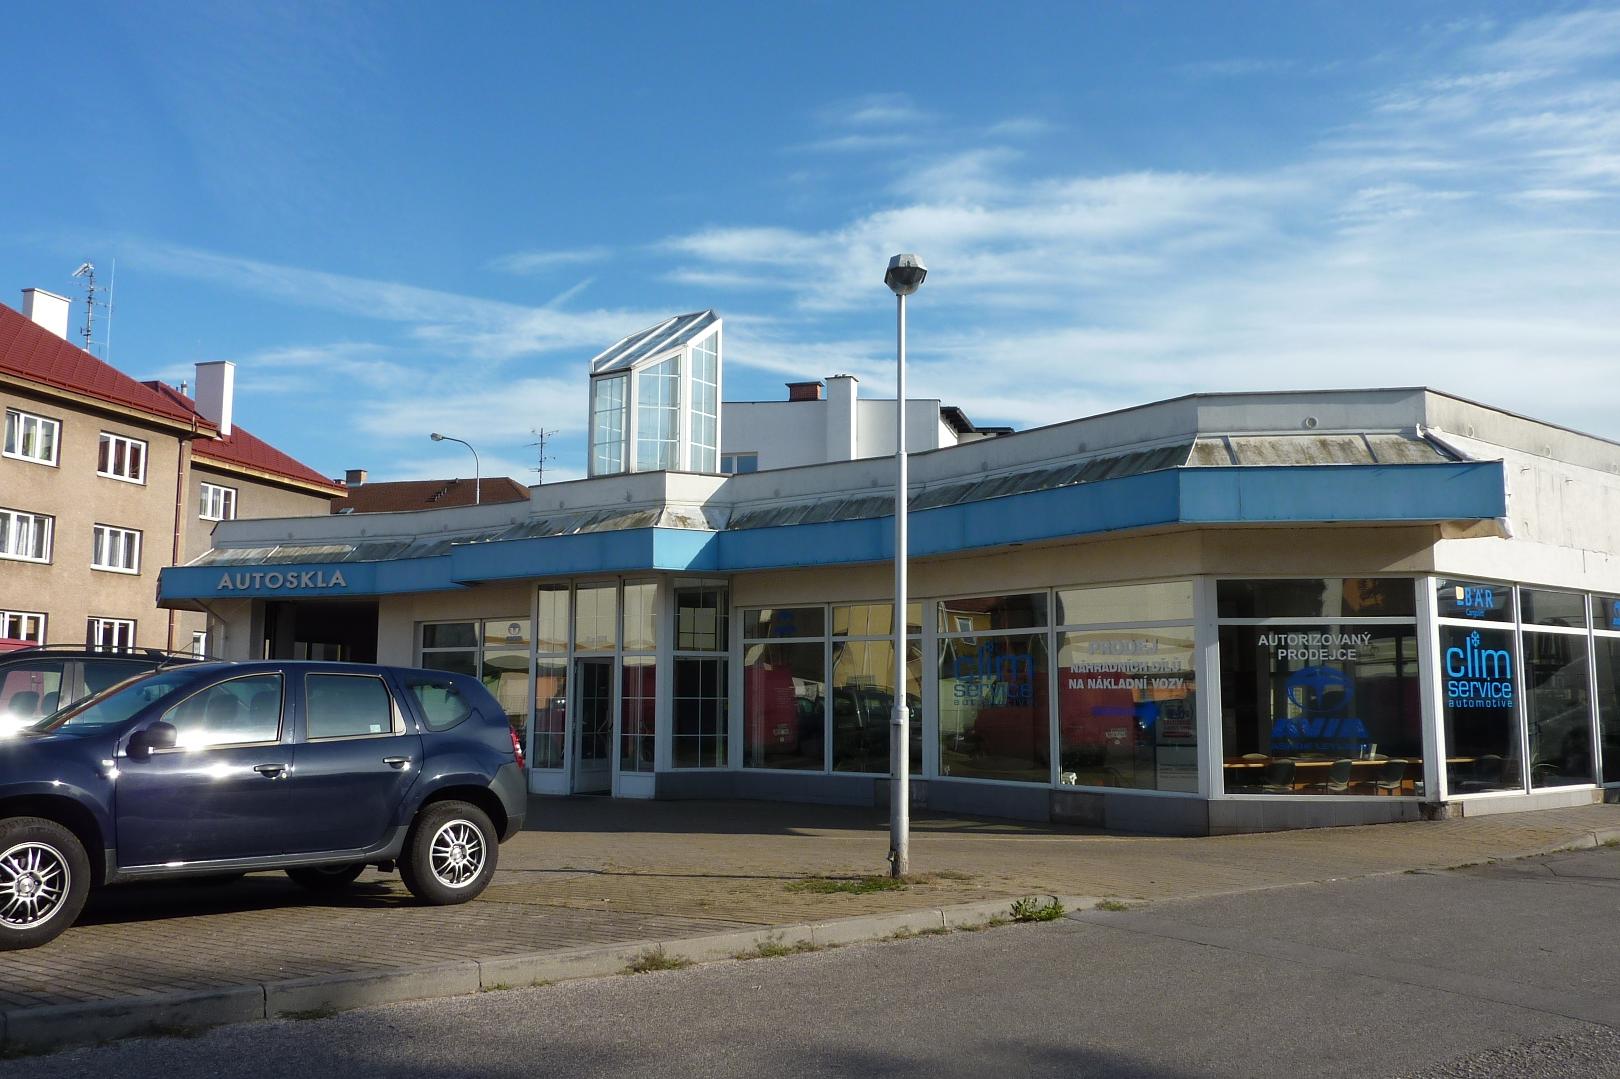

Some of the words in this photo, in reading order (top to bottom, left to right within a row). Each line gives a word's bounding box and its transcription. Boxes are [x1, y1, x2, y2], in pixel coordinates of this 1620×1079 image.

[216, 570, 347, 590] AUTOSKLA
[1464, 587, 1494, 608] BÄR
[1258, 631, 1372, 646] AUTORIZOVANÝ
[1088, 639, 1159, 655] PRODEJ
[1278, 649, 1357, 660] PRODEJCE
[954, 645, 1034, 682] clim
[1446, 636, 1511, 678] clim
[1071, 659, 1147, 673] NÁHRADNÍCH
[1068, 678, 1084, 689] NA
[1088, 676, 1147, 689] NÁKLADNÍ
[1152, 678, 1184, 689] VOZY
[1448, 677, 1512, 698] service
[1448, 699, 1513, 708] automotive
